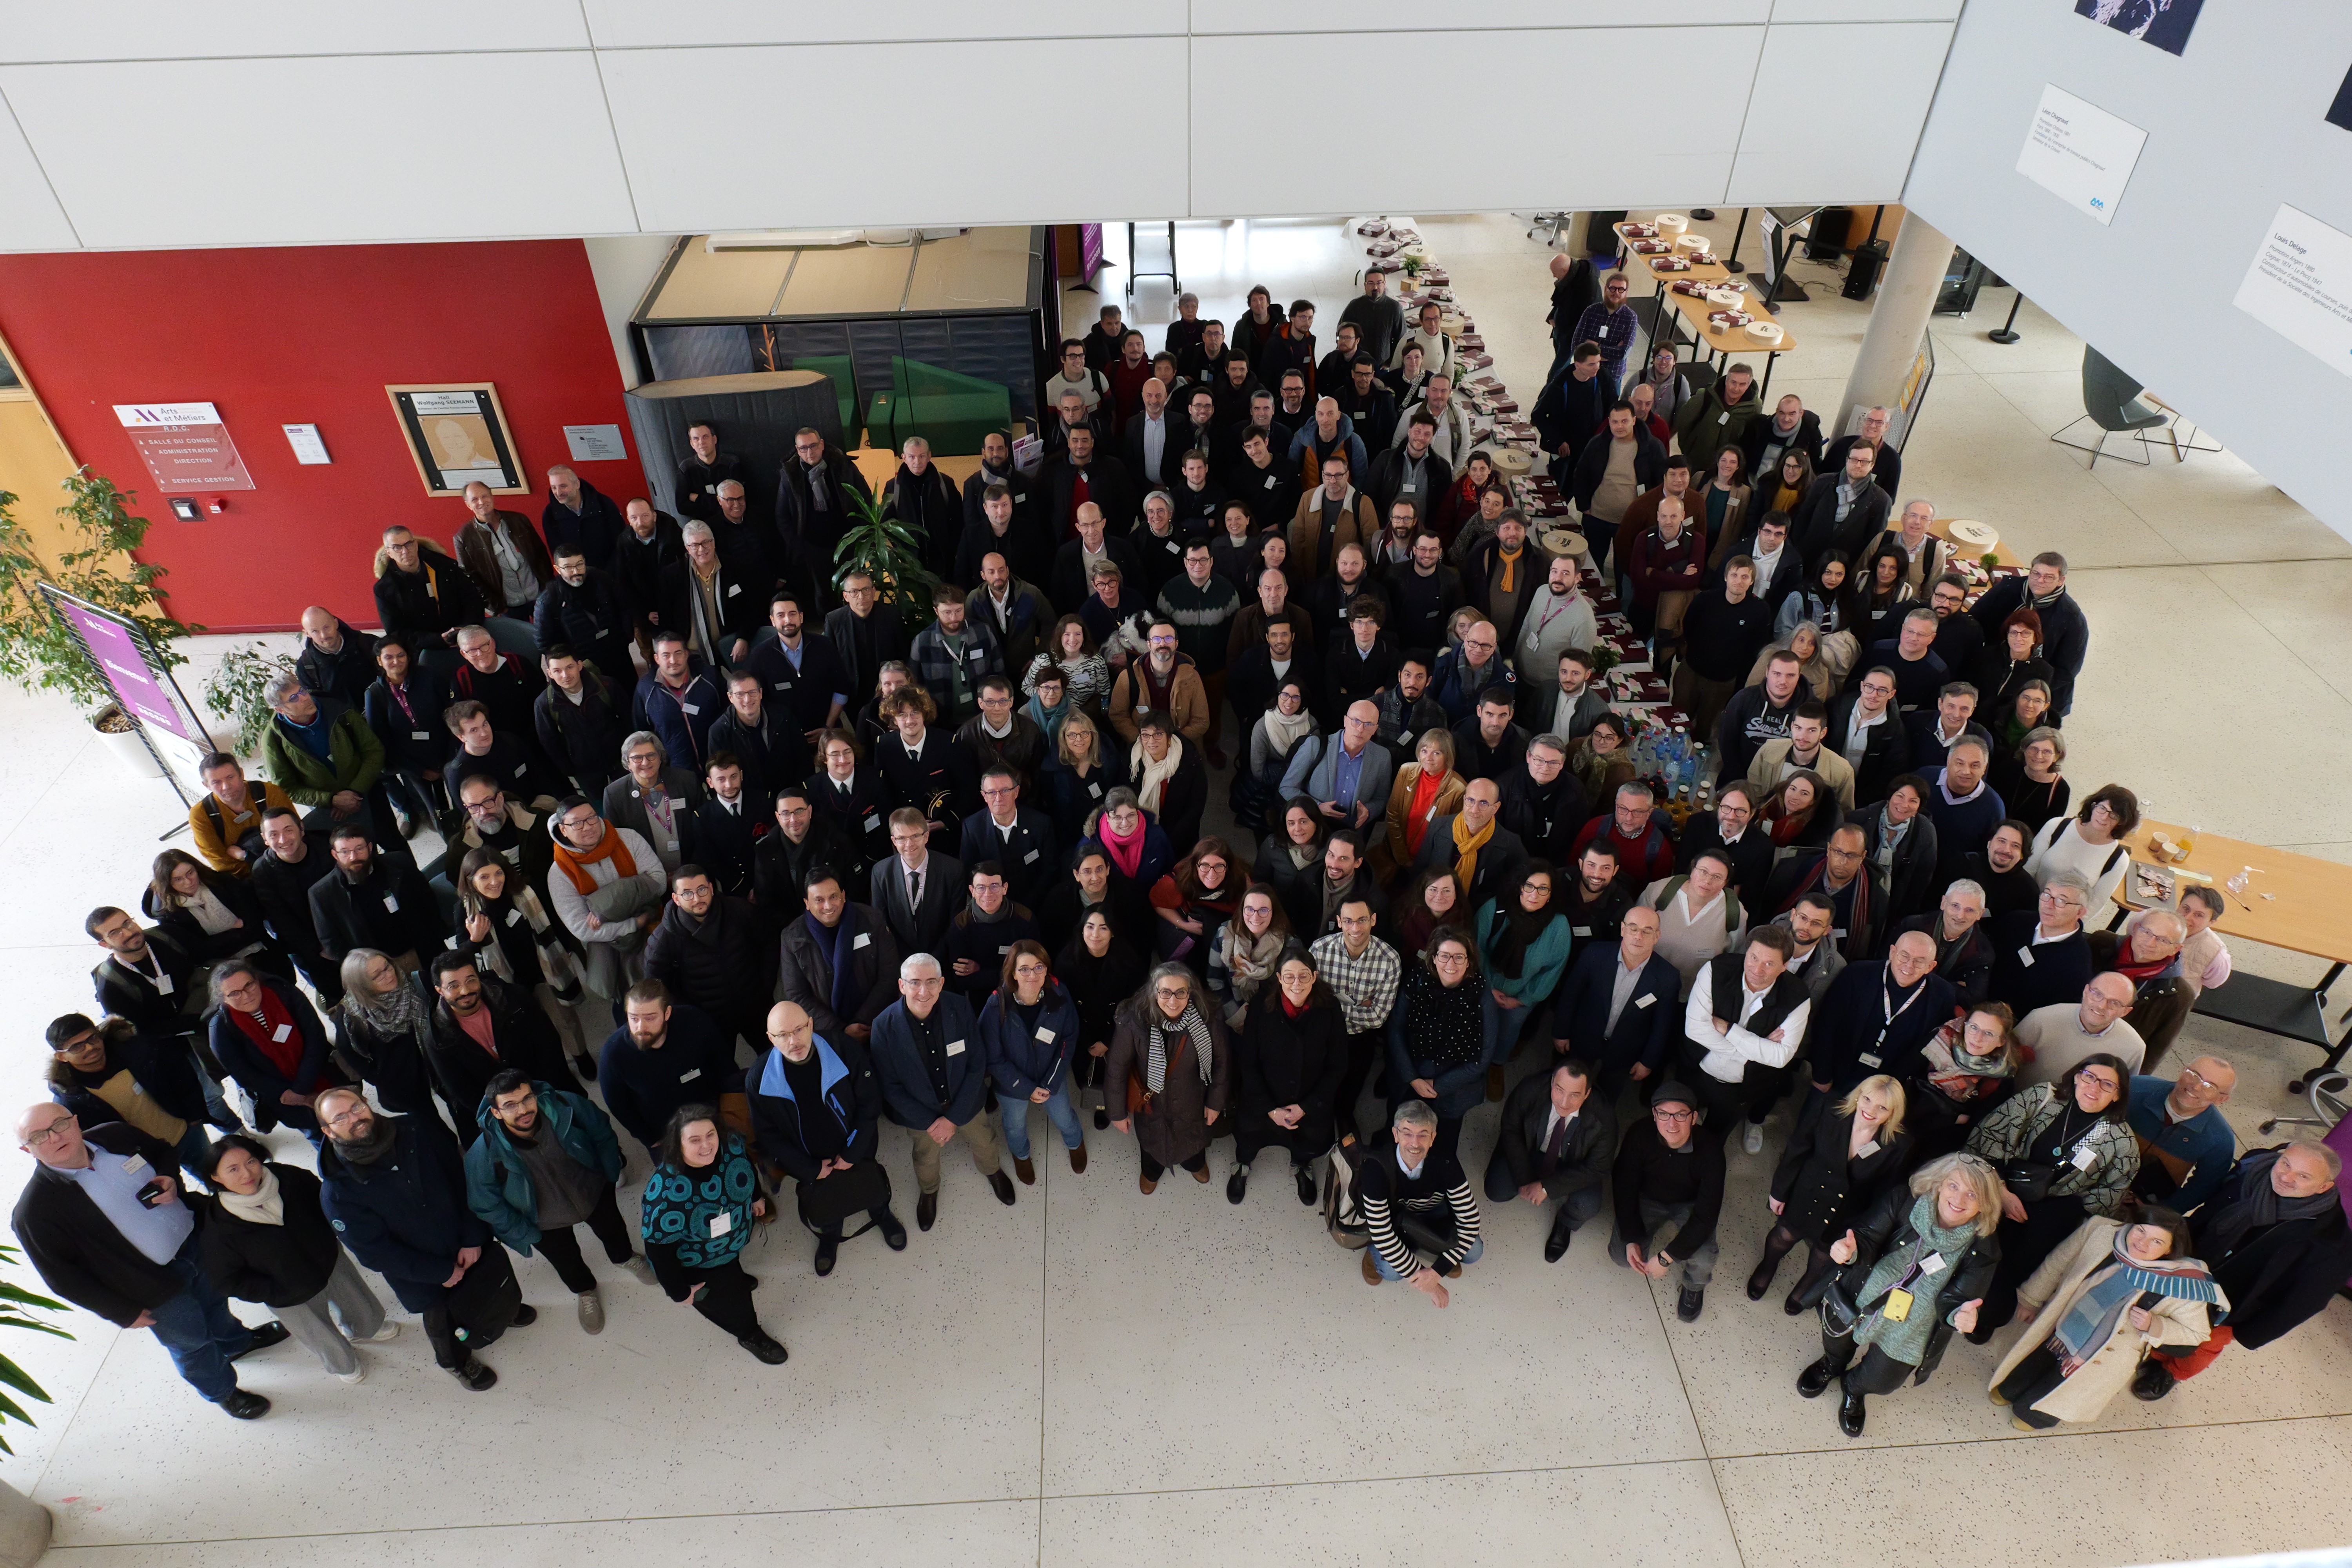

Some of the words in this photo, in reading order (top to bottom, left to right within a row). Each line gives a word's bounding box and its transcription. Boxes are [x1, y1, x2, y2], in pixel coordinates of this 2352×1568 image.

[2042, 107, 2051, 115] Léon
[2051, 112, 2069, 125] Chagnaud
[2080, 155, 2091, 163] publics
[2091, 160, 2106, 171] Chagnaud
[2274, 232, 2288, 245] Louis
[2288, 240, 2307, 255] Delage
[2265, 251, 2281, 263] Cognac
[2282, 260, 2292, 269] 1874
[2300, 271, 2311, 281] Pecq
[2312, 277, 2323, 286] 1947
[2269, 244, 2289, 259] Promotion
[2289, 256, 2304, 267] Angers
[2305, 264, 2316, 272] 1890
[2258, 265, 2277, 279] Président
[2287, 281, 2303, 293] Société
[2302, 290, 2310, 298] des
[2310, 295, 2332, 311] Ingénieurs
[2332, 308, 2341, 316] Arts
[2262, 258, 2287, 275] Constructeur
[2287, 272, 2315, 292] d'automobiles
[2321, 293, 2338, 306] courses,
[104, 658, 149, 685] Bienvenue
[1766, 715, 1782, 724] REAL
